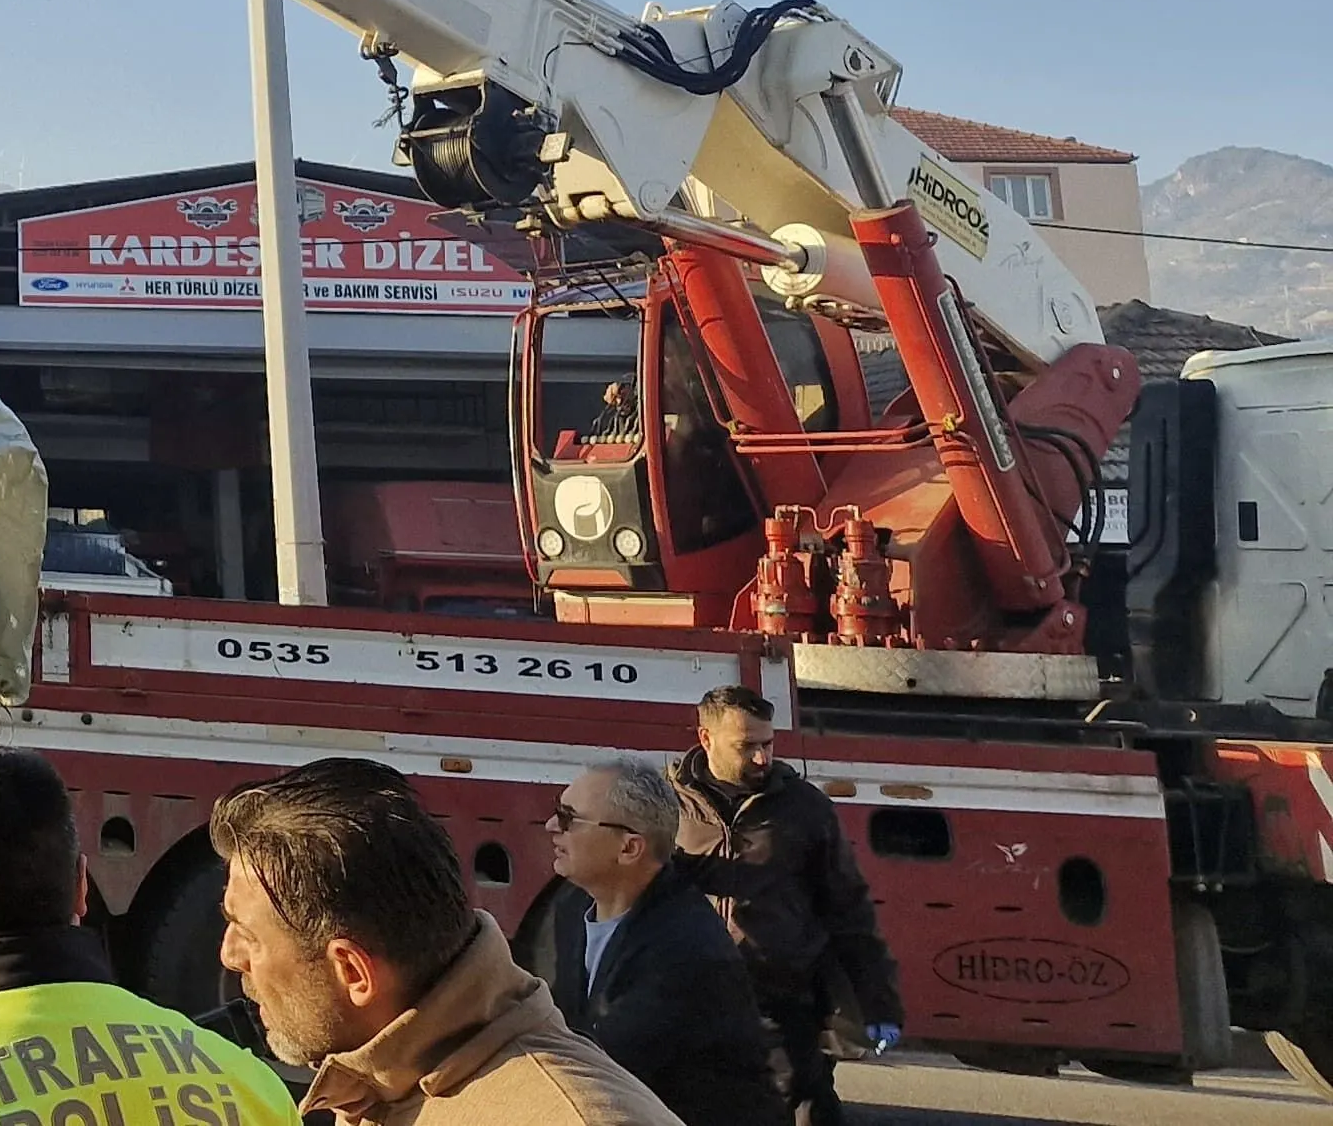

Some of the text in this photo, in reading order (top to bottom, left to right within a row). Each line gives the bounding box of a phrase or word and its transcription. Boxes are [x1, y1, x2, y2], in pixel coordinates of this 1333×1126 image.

[88, 234, 345, 274] KARDEŞER
[361, 231, 493, 272] DİZEL
[145, 279, 261, 296] HER TÜRLÜ DİZEL
[314, 286, 329, 298] ve
[334, 284, 379, 299] BAKIM
[384, 282, 438, 300] SERVİSİ
[451, 287, 503, 298] ISUZU
[216, 638, 330, 664] 0535
[415, 650, 499, 675] 513
